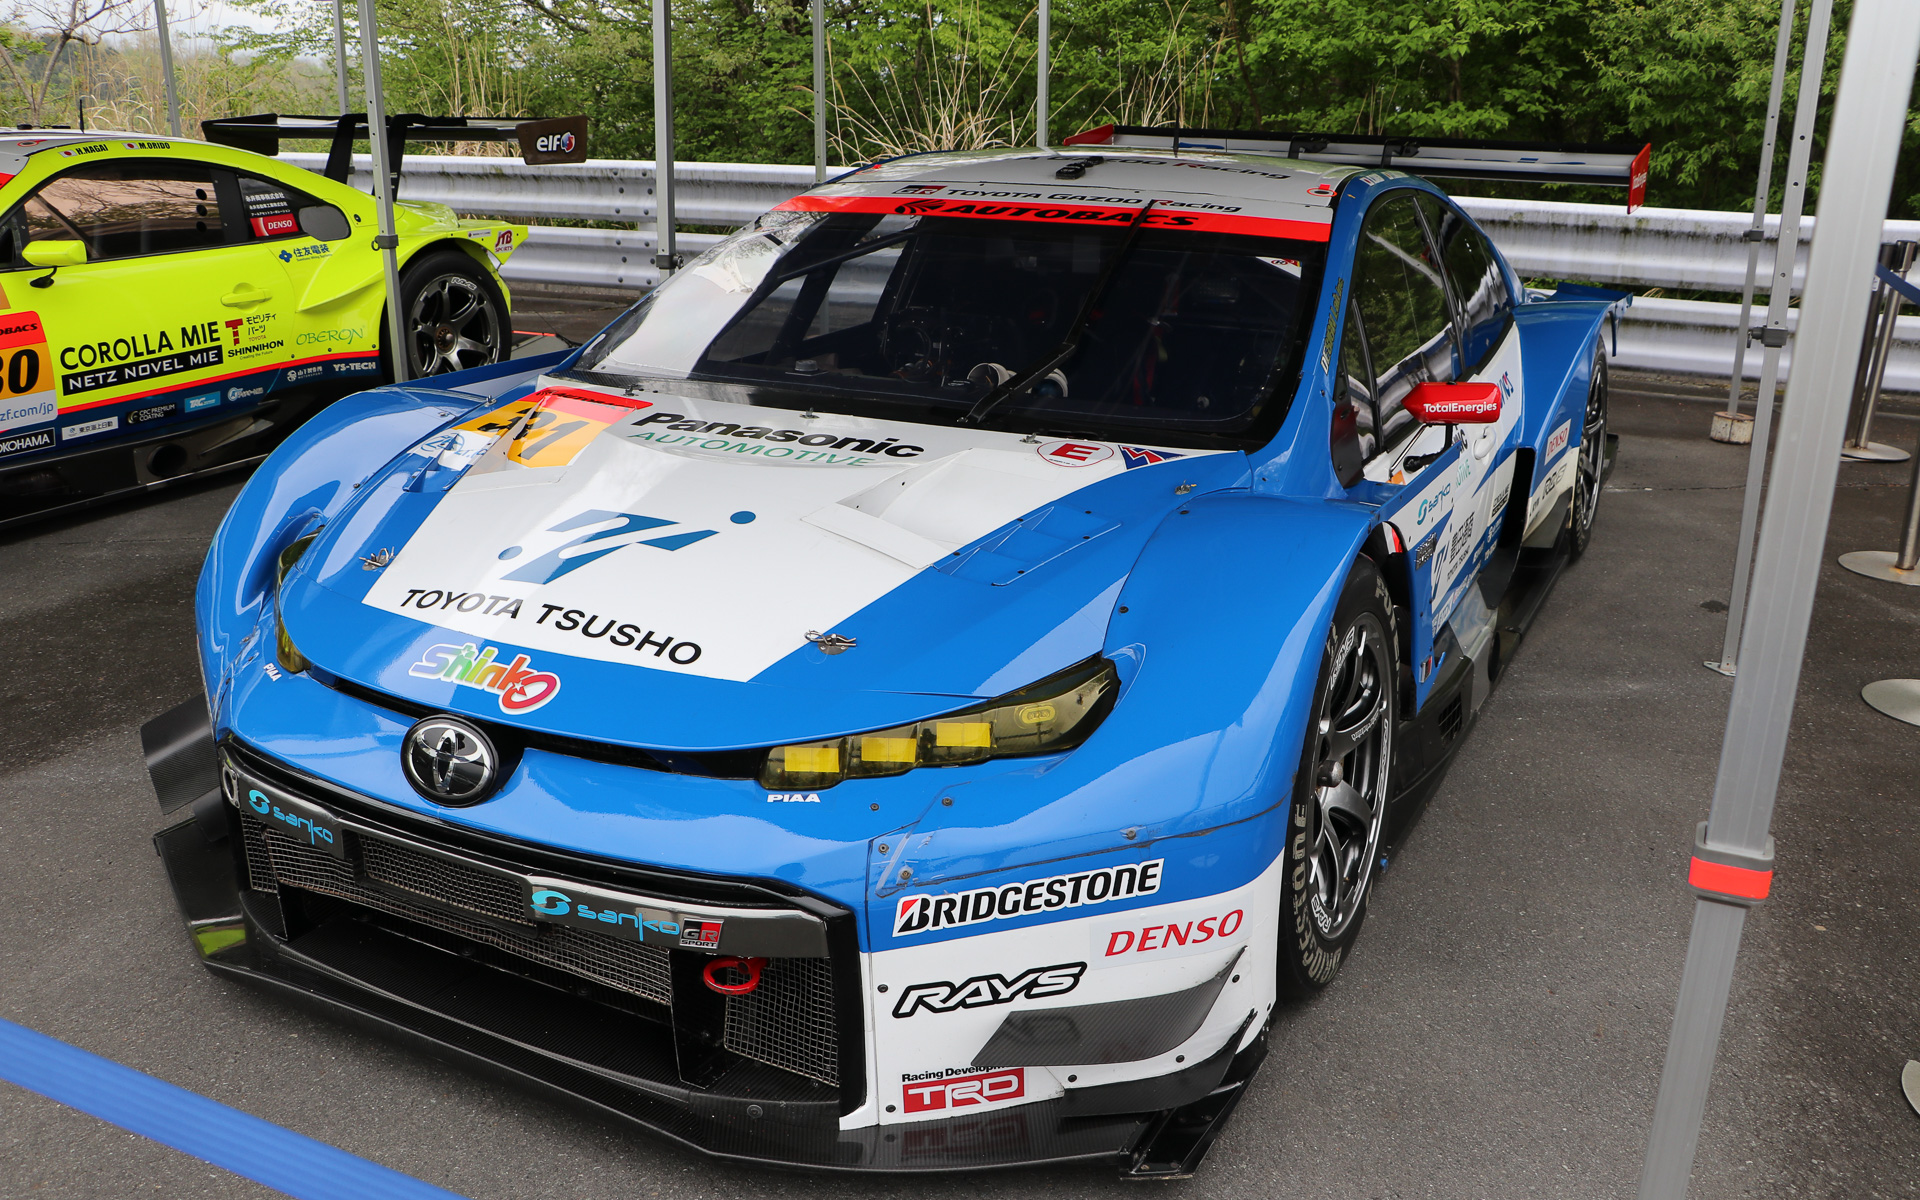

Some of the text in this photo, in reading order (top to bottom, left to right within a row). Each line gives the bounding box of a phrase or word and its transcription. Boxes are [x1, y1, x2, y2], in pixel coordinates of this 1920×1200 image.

[75, 144, 109, 155] H.NAGAI
[536, 135, 561, 151] elf
[1172, 162, 1292, 180] Racing
[947, 189, 1042, 199] TOYOTA
[1055, 192, 1143, 204] GAZOO
[1150, 199, 1243, 213] Racing
[267, 219, 293, 230] DENSO
[944, 204, 1200, 226] AUTOBACS
[495, 229, 513, 248] JTB
[293, 243, 330, 258] 住友電装
[246, 313, 277, 325] モビリティ
[0, 323, 38, 336] BACS
[247, 325, 266, 336] パーツ
[296, 328, 363, 346] OBERON
[60, 321, 221, 370] COROLLA MIE
[228, 340, 284, 358] SHINNIHON
[0, 349, 39, 394] 0
[69, 350, 219, 390] NETZ NOVEL MIE
[333, 362, 376, 371] YS-TECH
[139, 412, 165, 421] COATING
[151, 404, 176, 413] PREMIUM
[1423, 402, 1497, 414] TotalEnergies
[79, 420, 114, 433] 東京海上日動
[631, 412, 925, 458] Panasonic
[0, 434, 51, 453] KOHAMA
[627, 431, 876, 467] AUTOMOTIVE
[1547, 427, 1569, 458] DENSO
[1049, 443, 1101, 462] E
[400, 589, 702, 665] TOYOTA TSUSHO
[263, 662, 282, 681] PIAA
[408, 642, 561, 715] Shinko
[766, 793, 822, 803] PIAA
[273, 806, 334, 846] sanko
[897, 861, 1162, 934] BRIDGESTONE
[1292, 803, 1342, 984] BRIDGESTONE
[577, 904, 681, 941] sanko
[683, 928, 718, 941] GR
[1105, 909, 1244, 957] DENSO
[681, 939, 718, 948] SPORT
[892, 961, 1088, 1018] RAYS
[902, 1071, 944, 1082] Racing
[907, 1074, 1019, 1110] TRD
